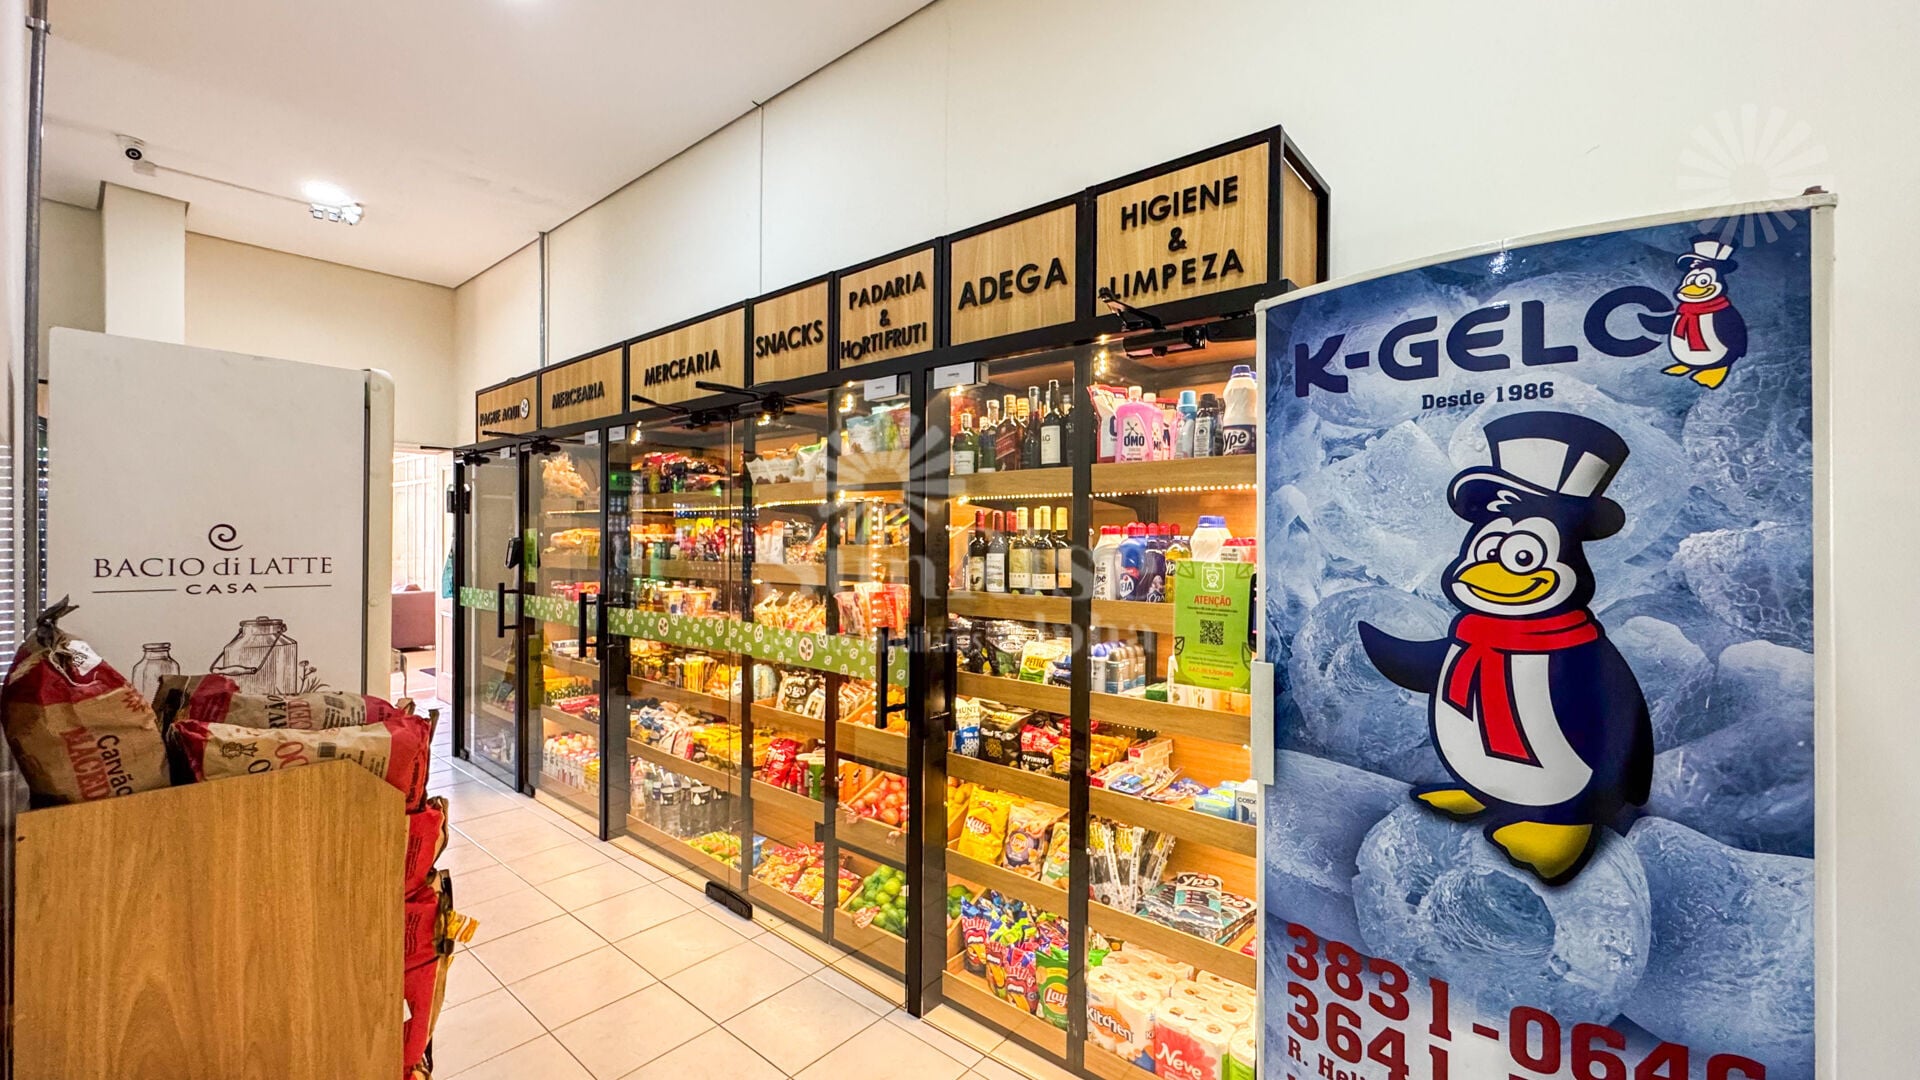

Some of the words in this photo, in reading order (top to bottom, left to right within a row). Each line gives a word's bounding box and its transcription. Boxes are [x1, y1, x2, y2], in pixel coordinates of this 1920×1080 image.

[1121, 175, 1239, 231] HIGIENE
[1168, 226, 1188, 252] &
[848, 271, 927, 310] PADARIA
[957, 257, 1068, 311] ADEGA
[1110, 248, 1245, 300] LIMPEZA
[879, 308, 891, 327] &
[755, 319, 825, 359] SNACKS
[1294, 285, 1676, 398] K-GELO
[644, 349, 721, 387] MERCEARIA
[551, 380, 606, 410] MERCEARIA
[1421, 389, 1485, 410] Desde
[1497, 381, 1555, 402] 1986
[479, 408, 501, 427] PAGUE
[502, 405, 520, 421] AQUI
[1123, 434, 1145, 447] OMO
[94, 557, 206, 578] BACIO
[212, 557, 241, 576] di
[249, 556, 333, 576] LATTE
[185, 582, 258, 595] CASA
[1193, 594, 1232, 608] ATENÇÃO
[1086, 1002, 1135, 1044] Kitchen
[1156, 1042, 1203, 1080] Neve
[1287, 1034, 1309, 1067] R.
